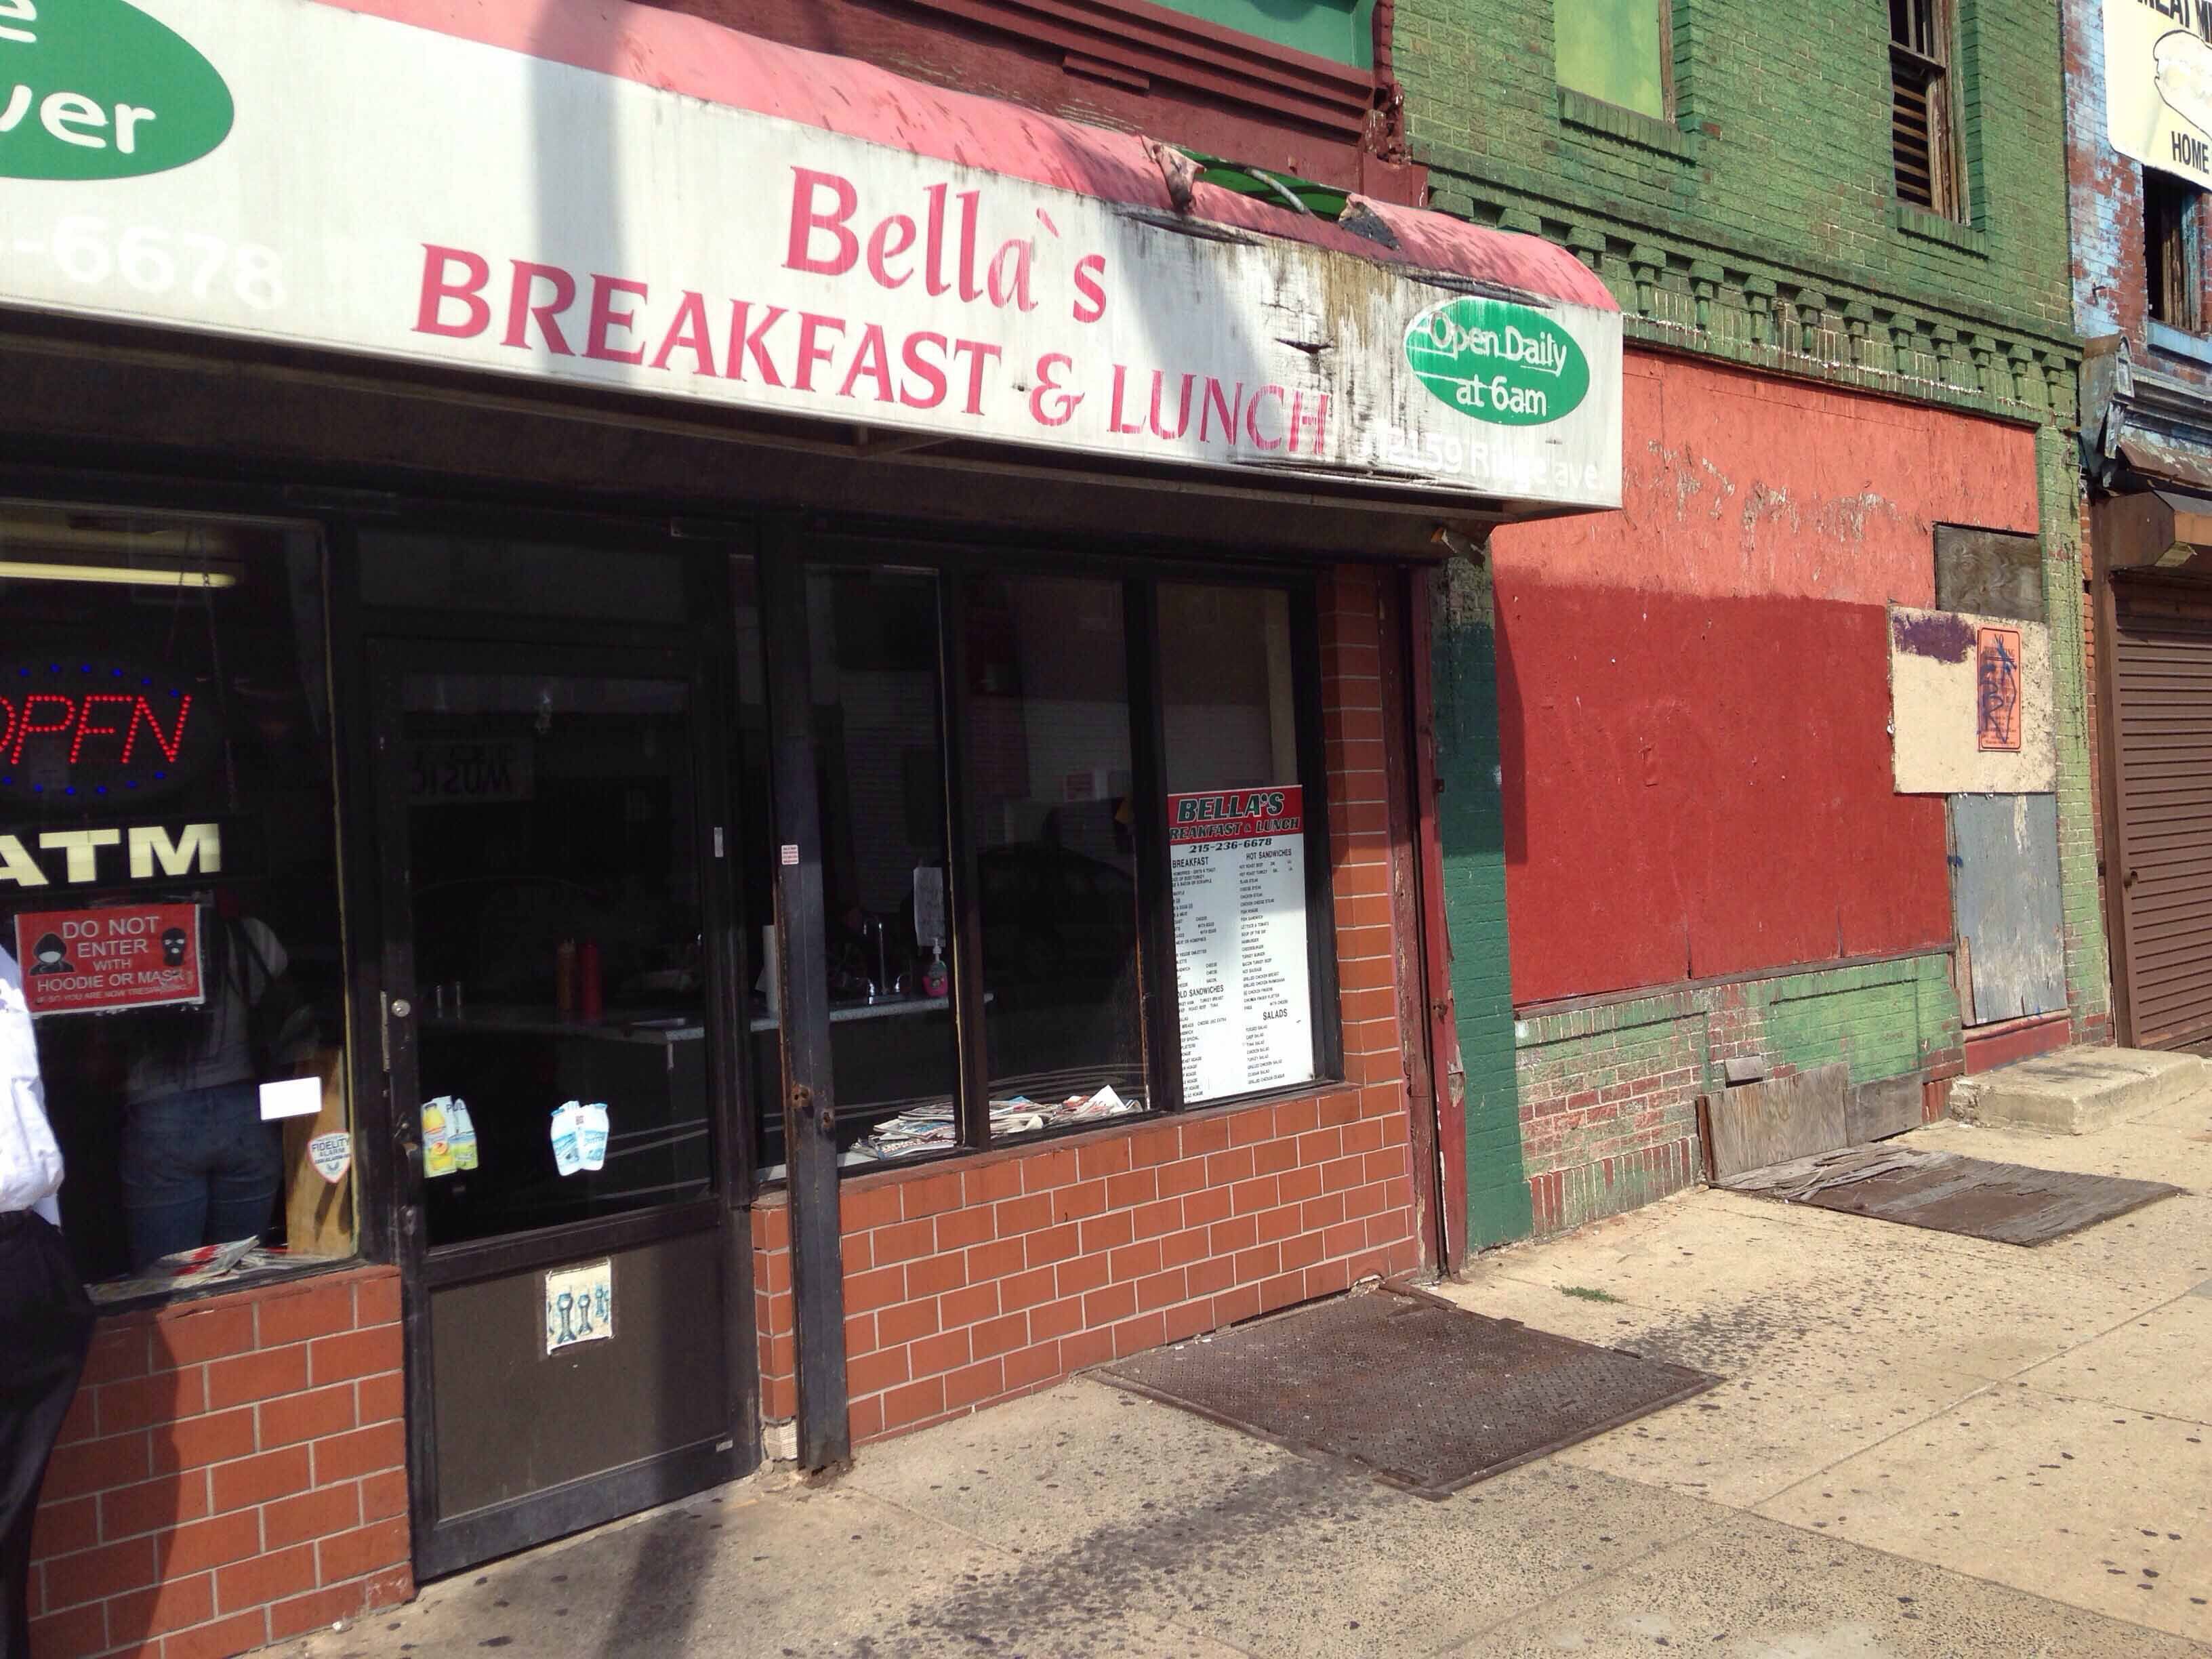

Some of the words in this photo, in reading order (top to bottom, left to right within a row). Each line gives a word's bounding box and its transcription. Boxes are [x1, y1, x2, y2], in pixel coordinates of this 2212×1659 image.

[2171, 130, 2209, 174] HOME
[410, 243, 1002, 417] BREAKFAST
[1028, 352, 1085, 427] &
[1107, 363, 1332, 455] LUNCH
[1429, 310, 1498, 361] Open
[1505, 325, 1568, 377] Daily
[1456, 374, 1484, 407] at
[1492, 376, 1547, 416] 6am
[1176, 792, 1285, 824] BELLA'S
[1169, 821, 1243, 841] REAKFAST
[1255, 817, 1300, 834] LUNCH
[0, 823, 221, 886] ATM
[1189, 838, 1273, 854] 215-236-6678
[1246, 852, 1256, 861] HOT
[1258, 848, 1292, 859] SANDWICHES
[1172, 856, 1209, 868] BREAKFAST
[62, 920, 98, 939] DO
[108, 916, 161, 937] NOT
[77, 938, 149, 958] ENTER
[92, 958, 131, 972] WITH
[37, 975, 103, 993] HOODIE
[108, 973, 134, 987] OR
[138, 969, 184, 985] MASK
[1177, 990, 1187, 998] OLD
[1189, 984, 1224, 998] SANDWICHES
[1263, 1008, 1288, 1021] SALADS
